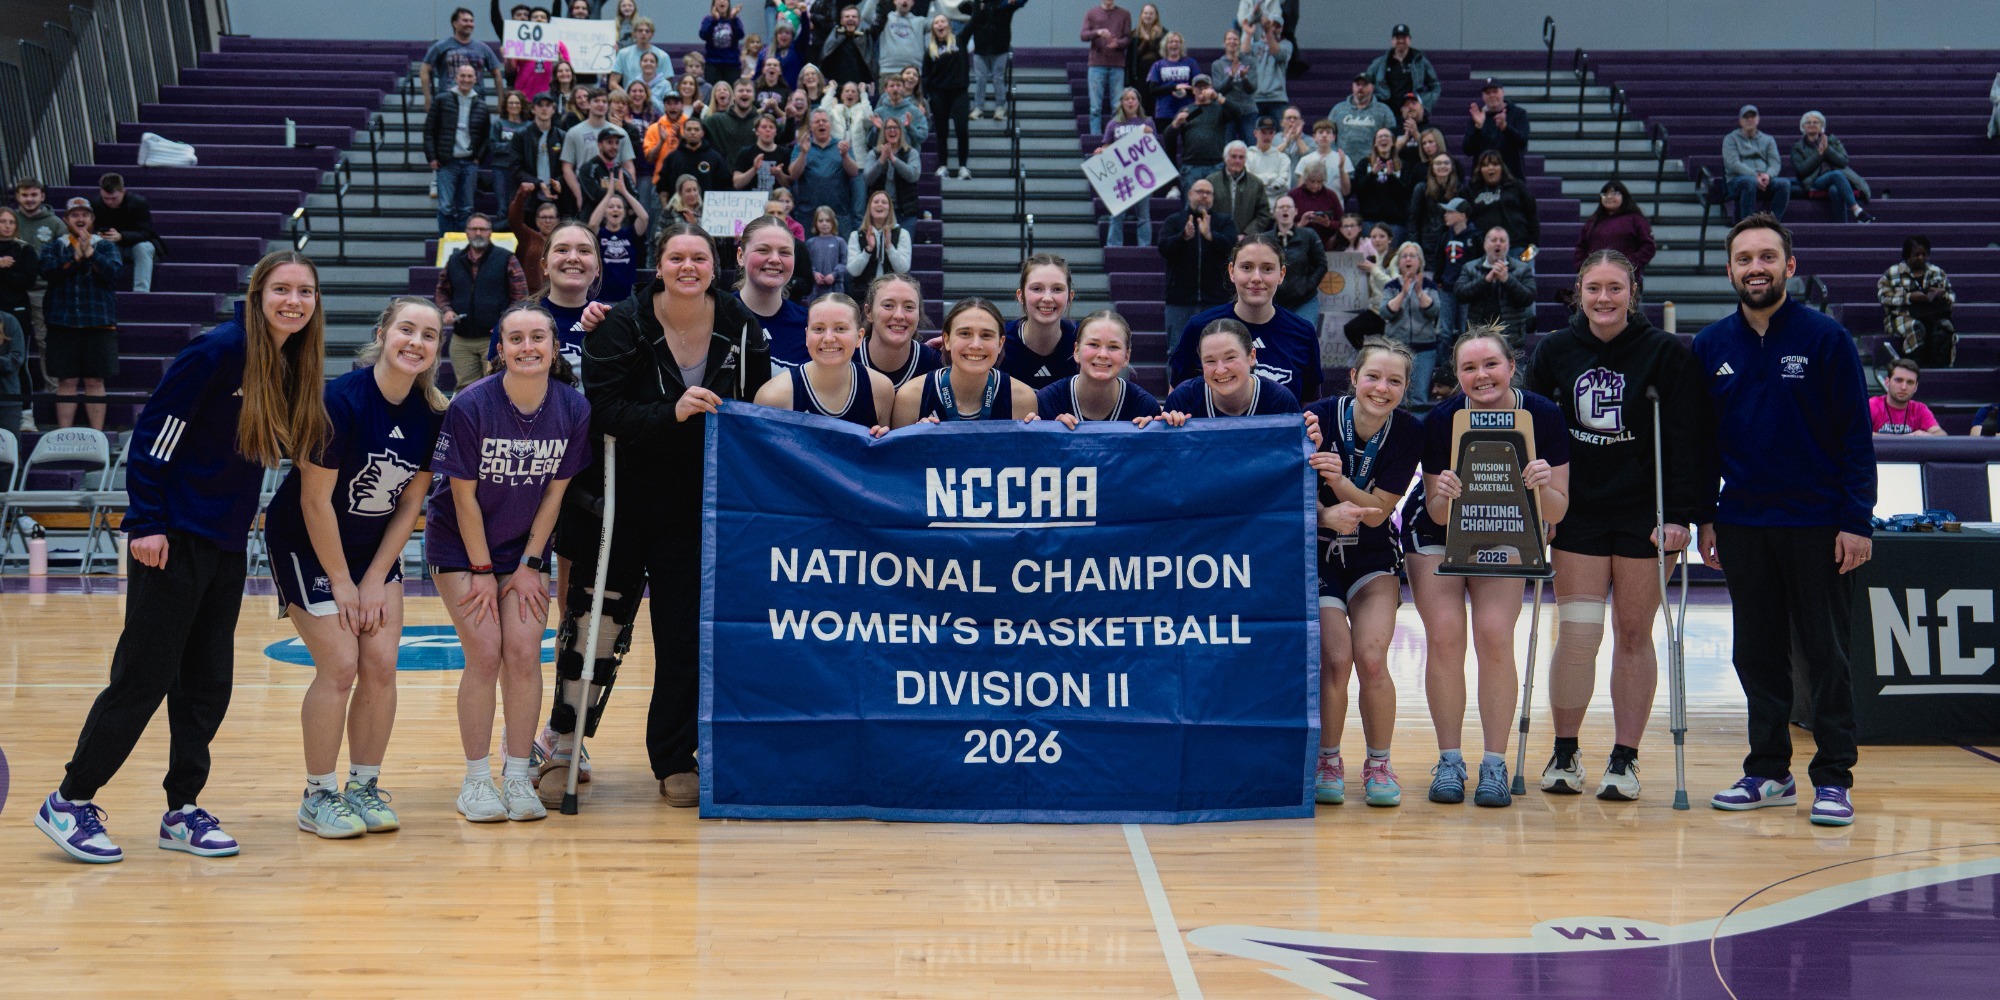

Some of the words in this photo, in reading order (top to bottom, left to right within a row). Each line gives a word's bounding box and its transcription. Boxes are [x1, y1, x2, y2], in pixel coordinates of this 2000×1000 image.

[518, 24, 542, 41] GO
[1087, 158, 1118, 182] We
[1114, 135, 1157, 168] Love
[707, 192, 740, 207] Better
[1781, 355, 1809, 365] CROWN
[1471, 412, 1514, 427] NCCAA
[1471, 463, 1504, 472] DIVISION
[1505, 463, 1511, 472] II
[1473, 473, 1509, 482] WOMEN'S
[926, 466, 1097, 519] NCCAA
[1469, 483, 1515, 492] BASKETBALL
[1461, 504, 1522, 518] NATIONAL
[1461, 519, 1524, 532] CHAMPION
[1477, 551, 1508, 563] 2026
[770, 547, 997, 594] NATIONAL
[1011, 553, 1251, 594] CHAMPION
[768, 608, 980, 645] WOMEN'S
[993, 614, 1251, 647] BASKETBALL
[896, 670, 1091, 708] DIVISION
[1107, 672, 1129, 708] II
[963, 728, 1062, 764] 2026
[1550, 926, 1661, 941] TM
